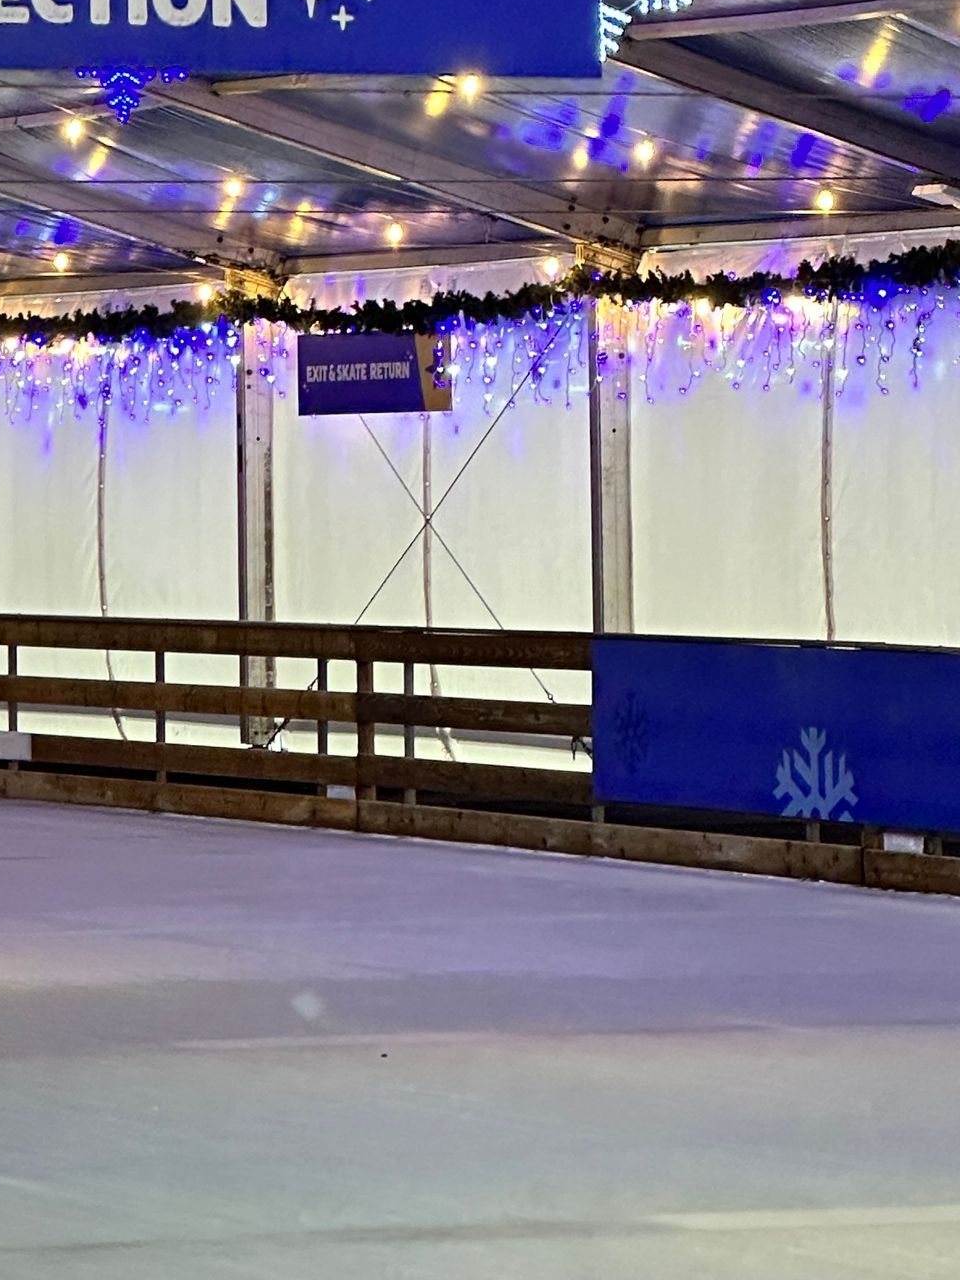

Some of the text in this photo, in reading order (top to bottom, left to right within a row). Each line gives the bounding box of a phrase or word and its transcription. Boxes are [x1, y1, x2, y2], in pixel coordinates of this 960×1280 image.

[306, 361, 410, 383] EXIT & SKATE RETURN
